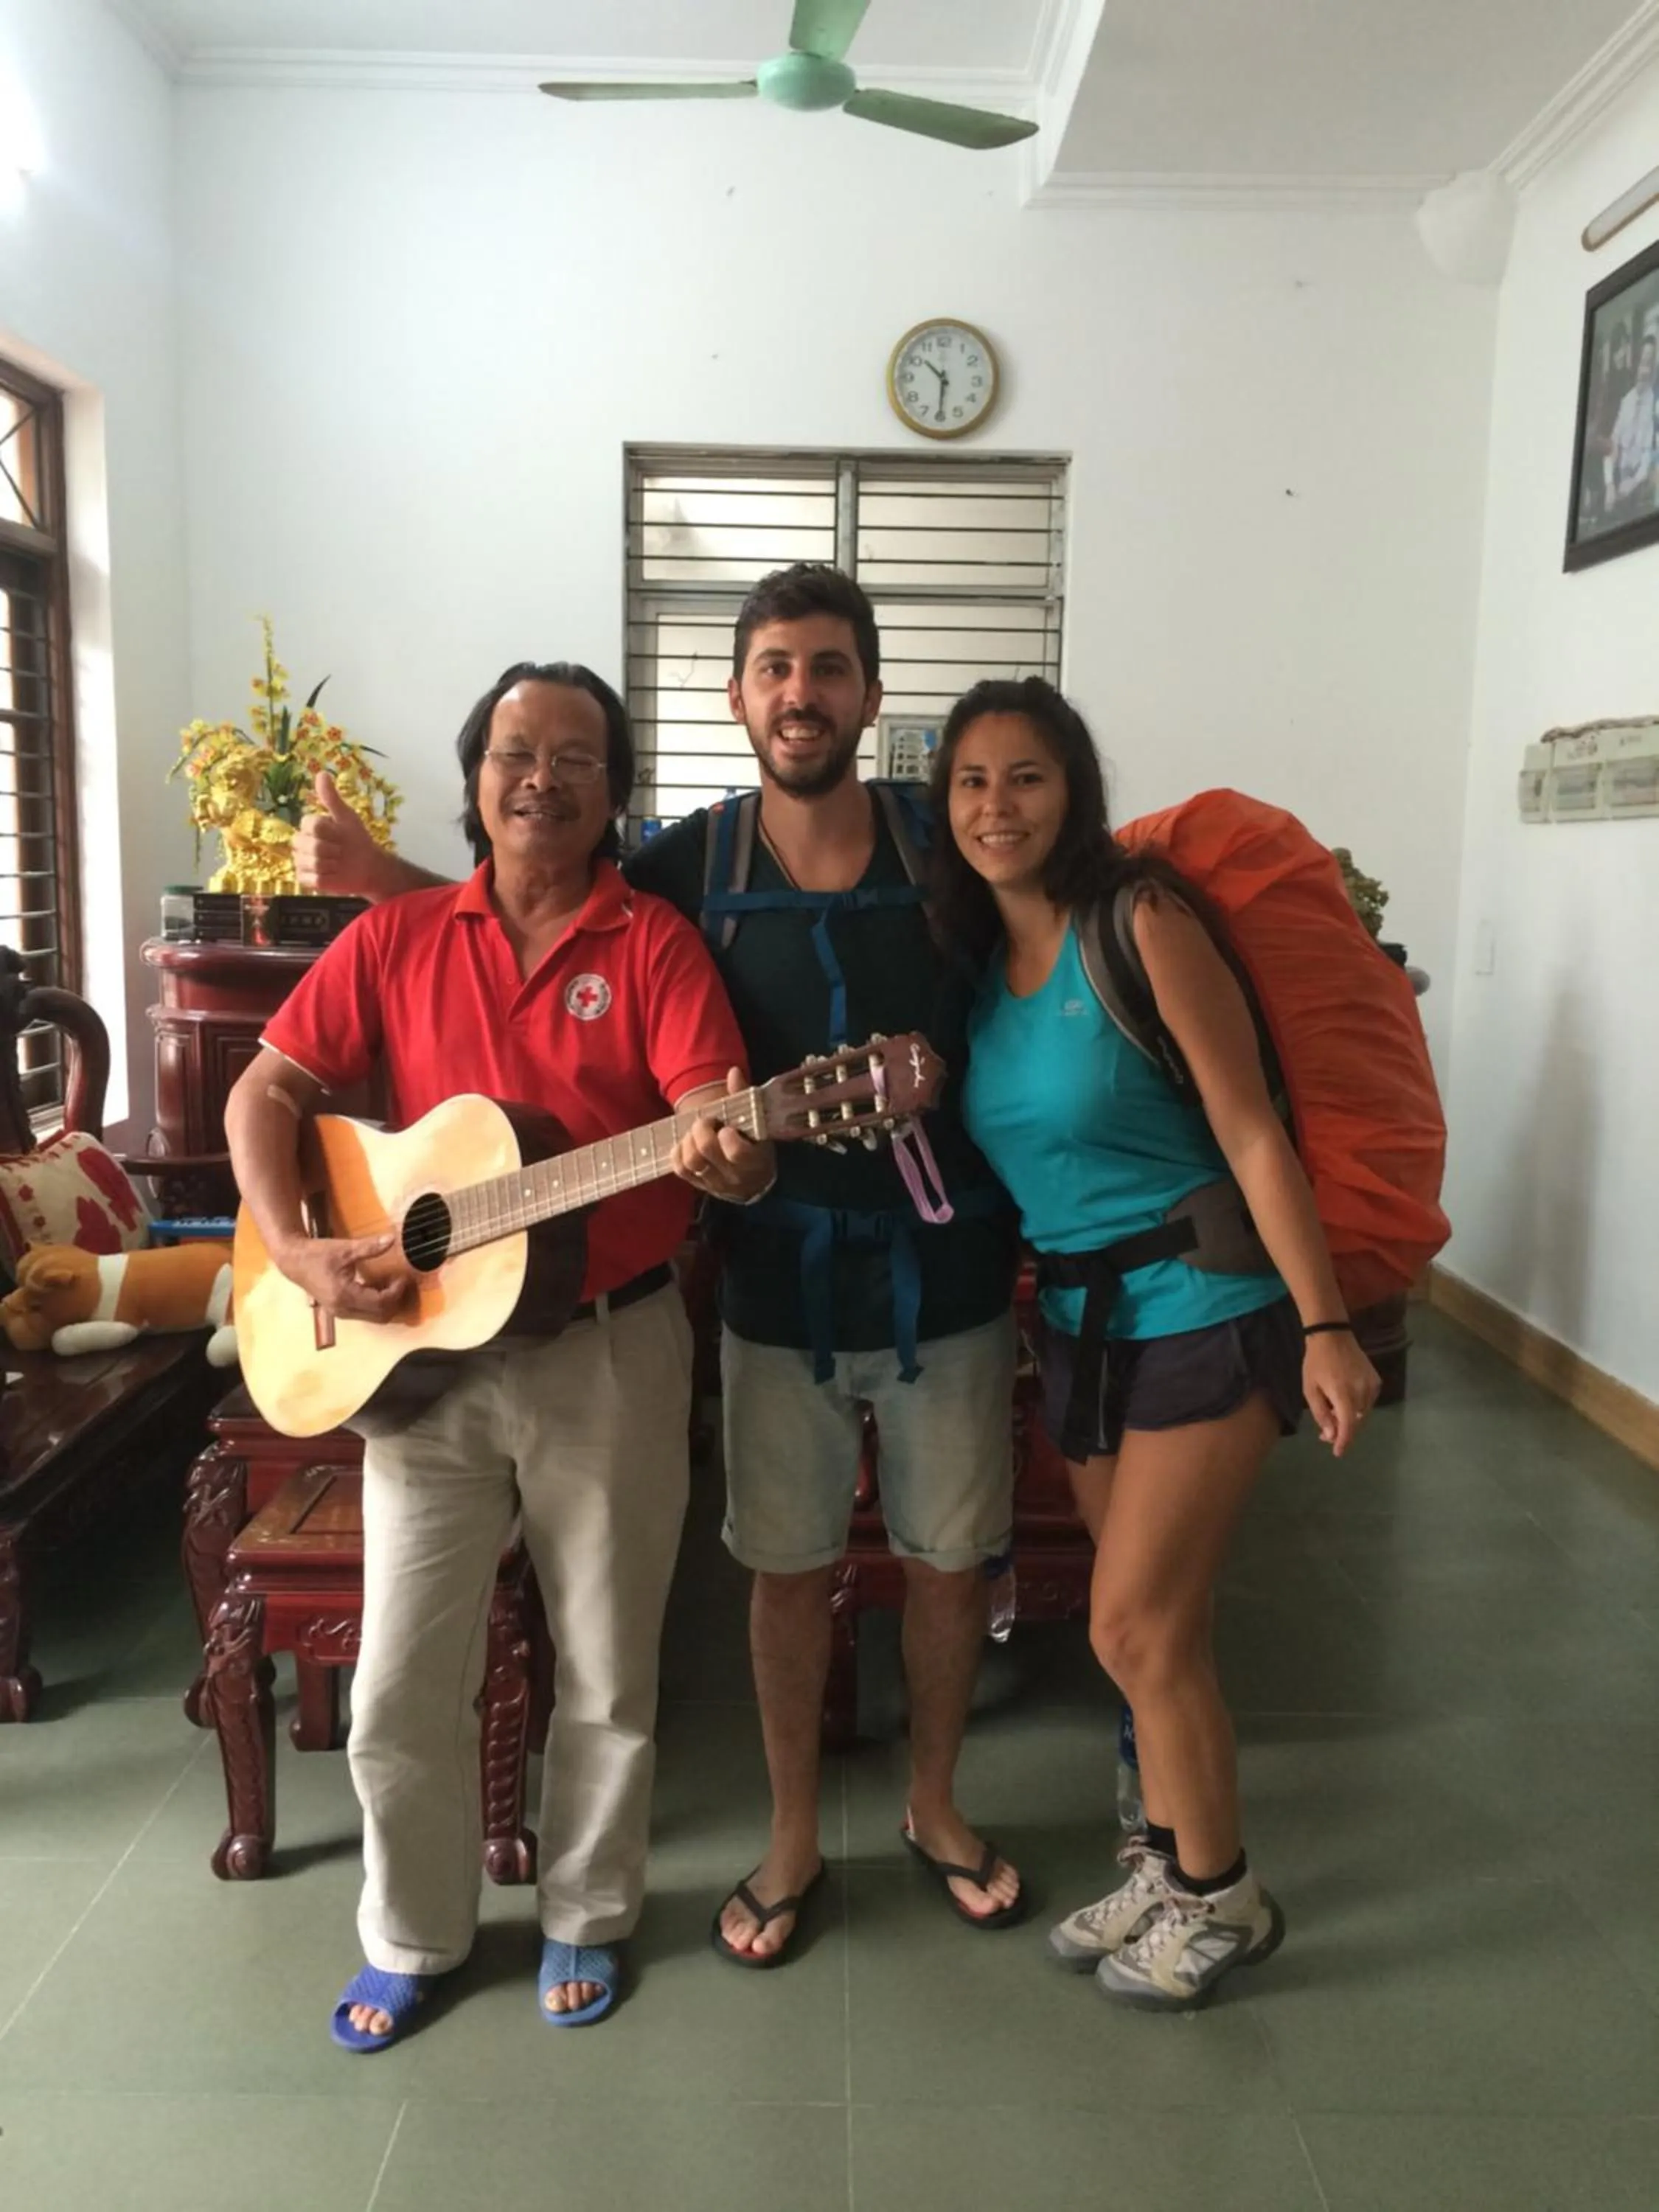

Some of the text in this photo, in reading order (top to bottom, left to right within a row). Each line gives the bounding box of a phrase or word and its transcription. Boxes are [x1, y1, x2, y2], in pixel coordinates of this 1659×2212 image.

[967, 355, 978, 366] 2
[971, 375, 982, 388] 3
[907, 391, 919, 403] 8
[965, 393, 976, 403] 4
[919, 405, 929, 417] 7
[952, 406, 964, 418] 5
